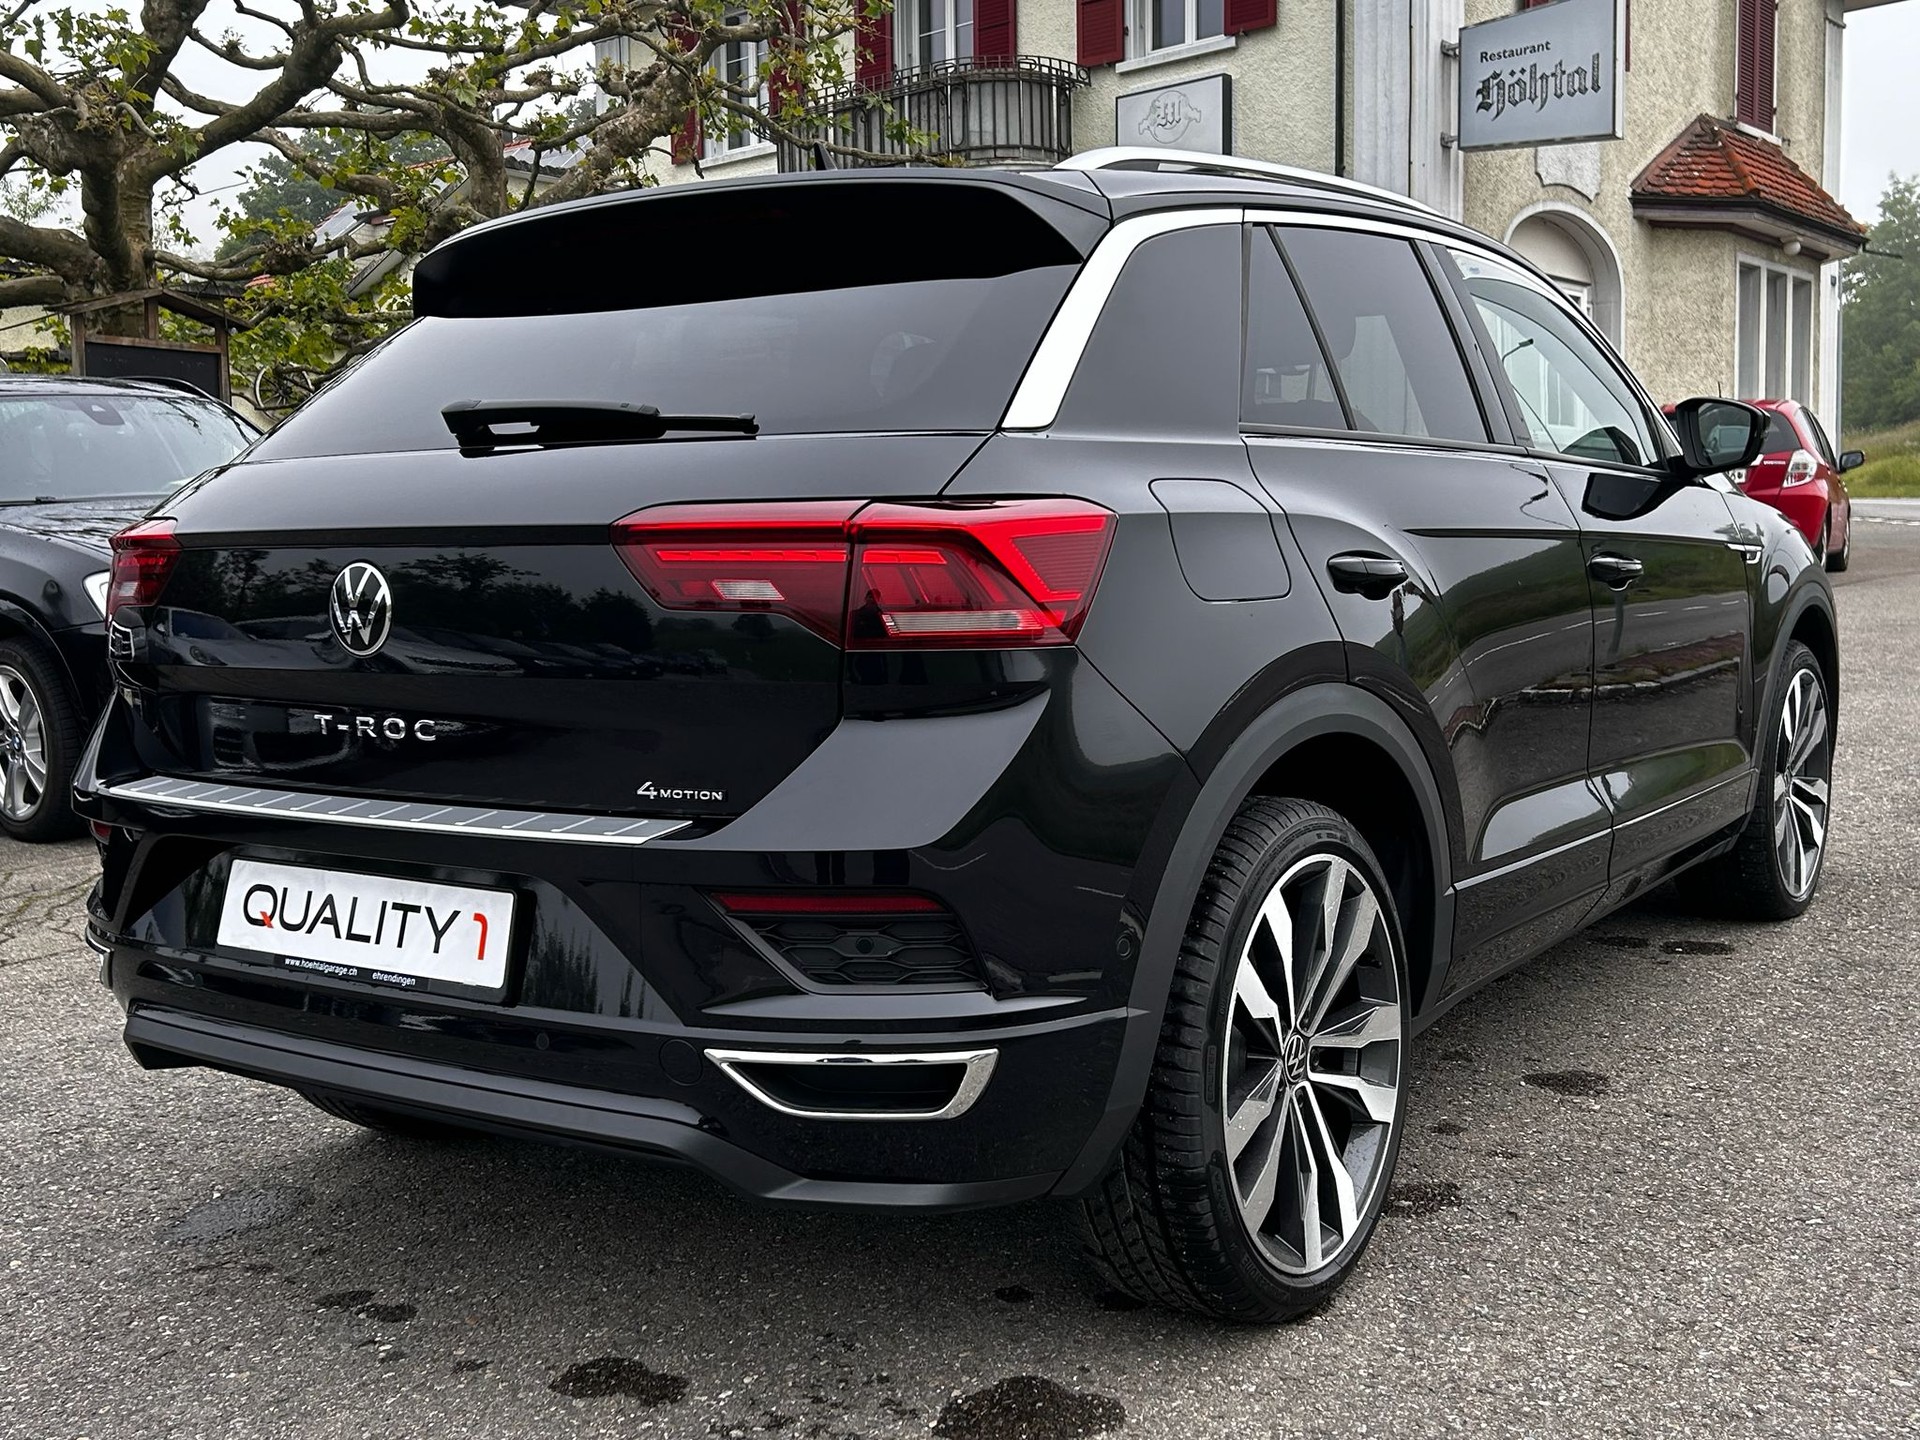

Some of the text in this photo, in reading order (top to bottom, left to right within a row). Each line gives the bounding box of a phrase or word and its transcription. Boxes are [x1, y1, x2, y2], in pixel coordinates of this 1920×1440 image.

[1480, 40, 1551, 63] Restaurant
[314, 714, 436, 742] T-ROC
[637, 781, 723, 801] 4MOTION
[243, 883, 461, 954] QUALITY
[372, 971, 416, 987] ehrendingen
